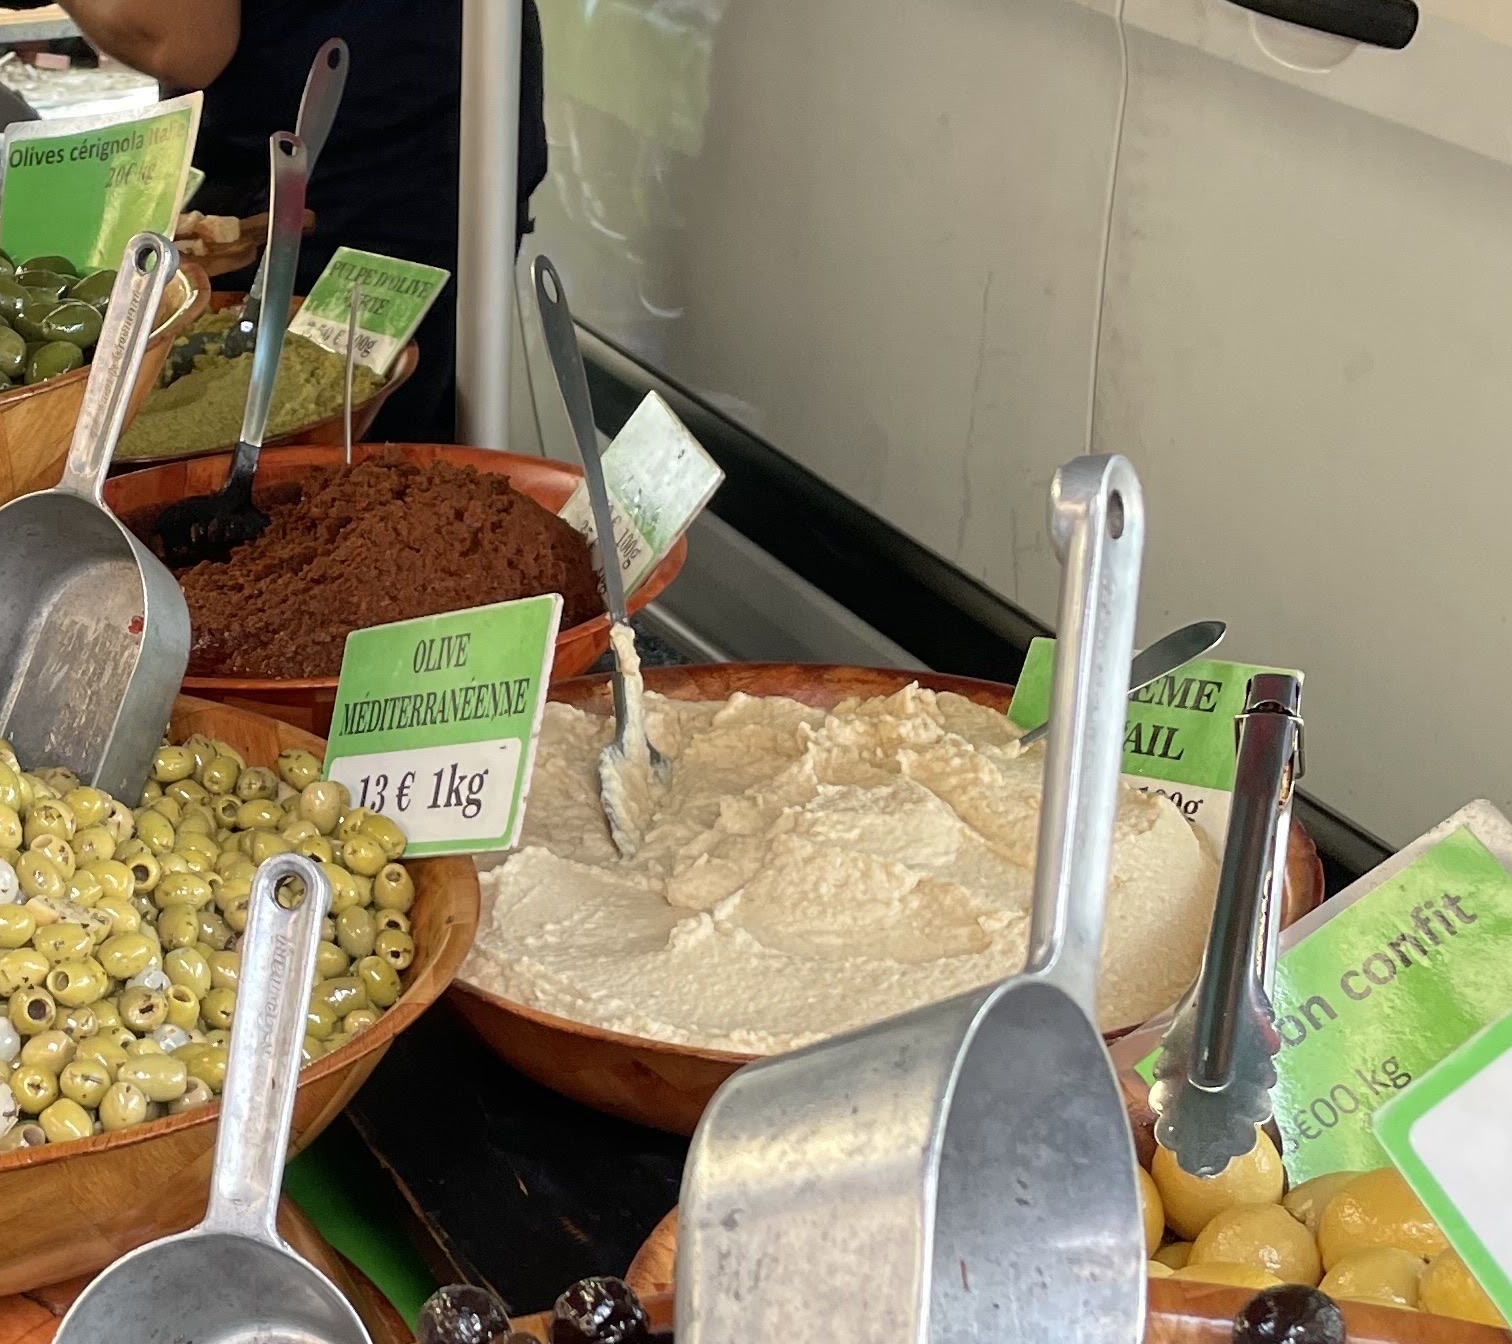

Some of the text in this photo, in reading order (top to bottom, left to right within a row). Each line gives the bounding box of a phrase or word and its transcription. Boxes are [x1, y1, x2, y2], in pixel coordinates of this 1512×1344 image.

[8, 146, 65, 168] Olives
[69, 130, 145, 163] cérignola
[412, 632, 472, 675] OLIVE
[338, 677, 531, 737] MÉDITERRANÉENNE
[1129, 674, 1223, 713] EME
[359, 762, 490, 819] 13 € 1kg
[1339, 892, 1478, 1002] confit
[1354, 1055, 1413, 1097] kg
